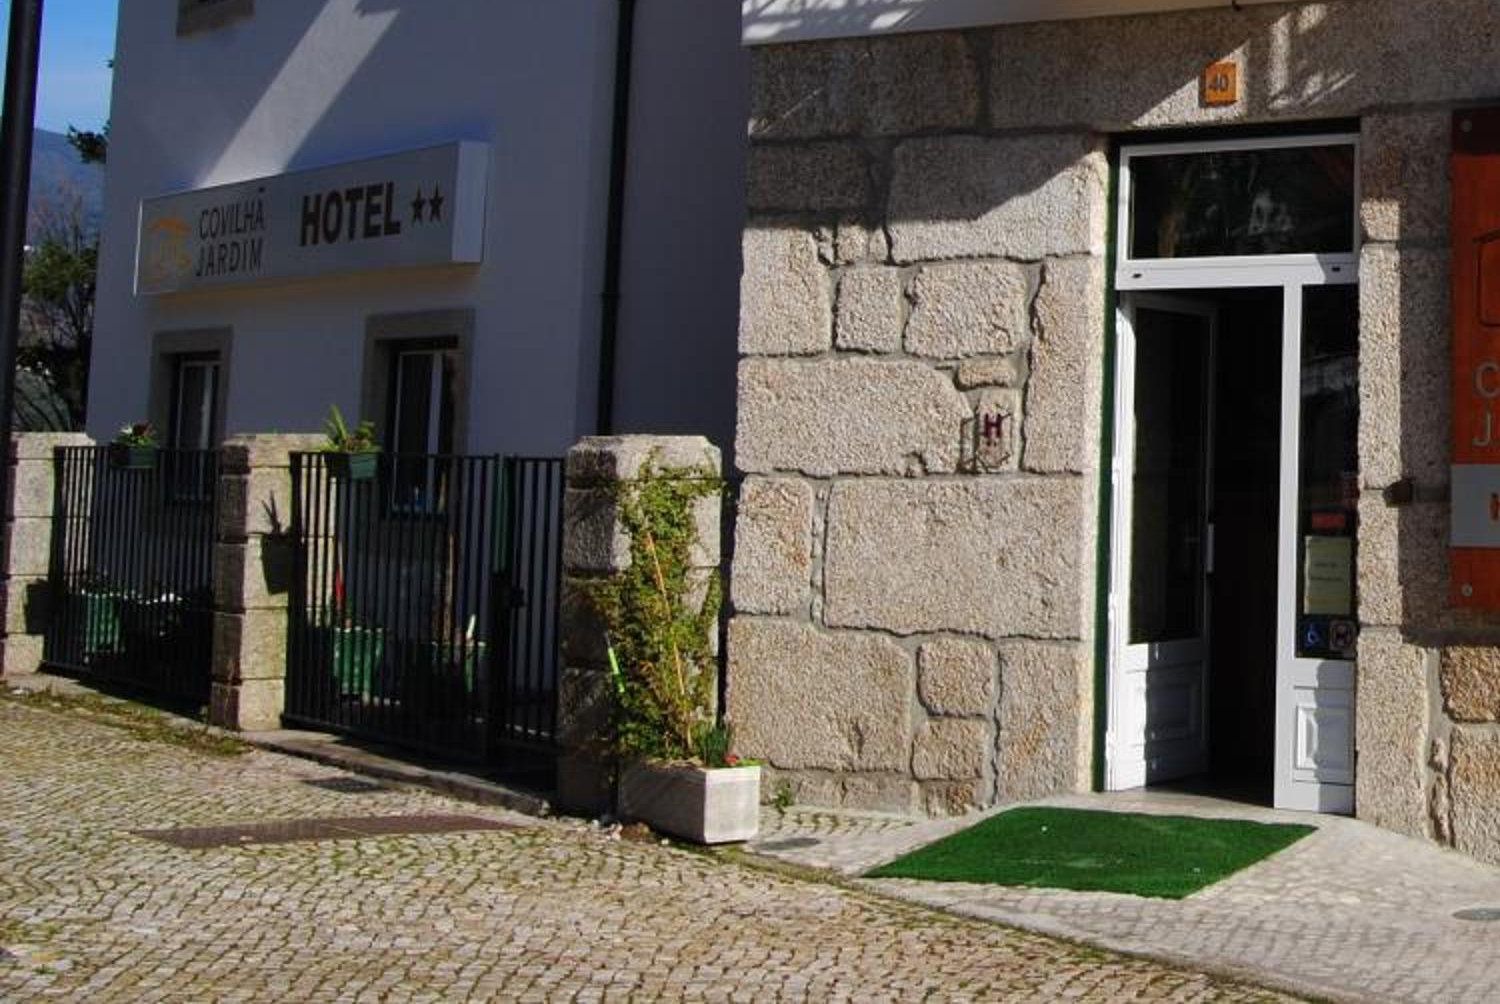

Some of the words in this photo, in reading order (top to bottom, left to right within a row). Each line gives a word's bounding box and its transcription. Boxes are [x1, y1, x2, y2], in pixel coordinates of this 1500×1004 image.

[1208, 73, 1229, 91] 40
[300, 182, 401, 246] HOTEL
[196, 239, 263, 277] JARDIM
